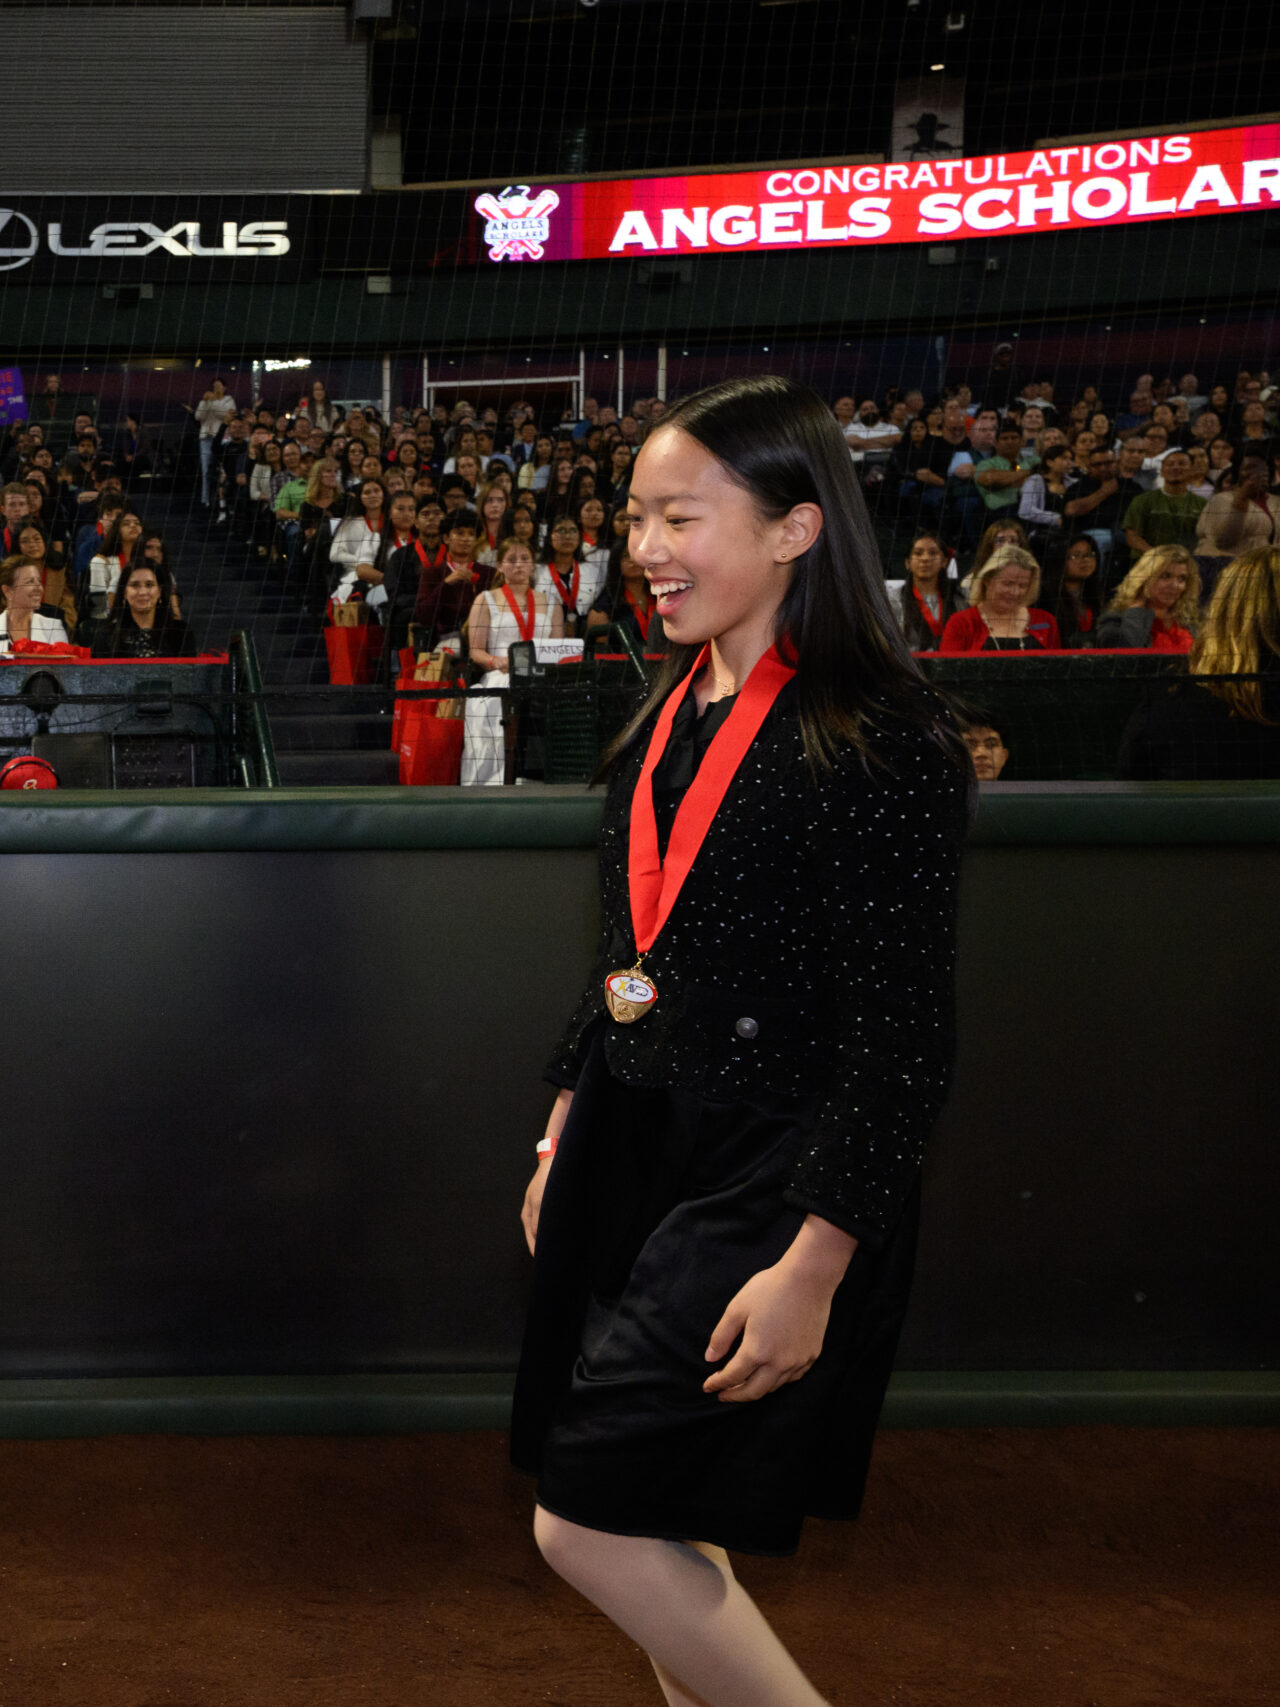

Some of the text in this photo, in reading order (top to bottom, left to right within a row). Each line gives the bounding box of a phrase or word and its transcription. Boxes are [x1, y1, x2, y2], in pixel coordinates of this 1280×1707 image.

[766, 136, 1193, 197] CONGRATULATIONS
[48, 221, 291, 256] LEXUS
[491, 219, 544, 231] ANGELS
[608, 197, 892, 252] ANGELS
[540, 645, 584, 656] ANGELS
